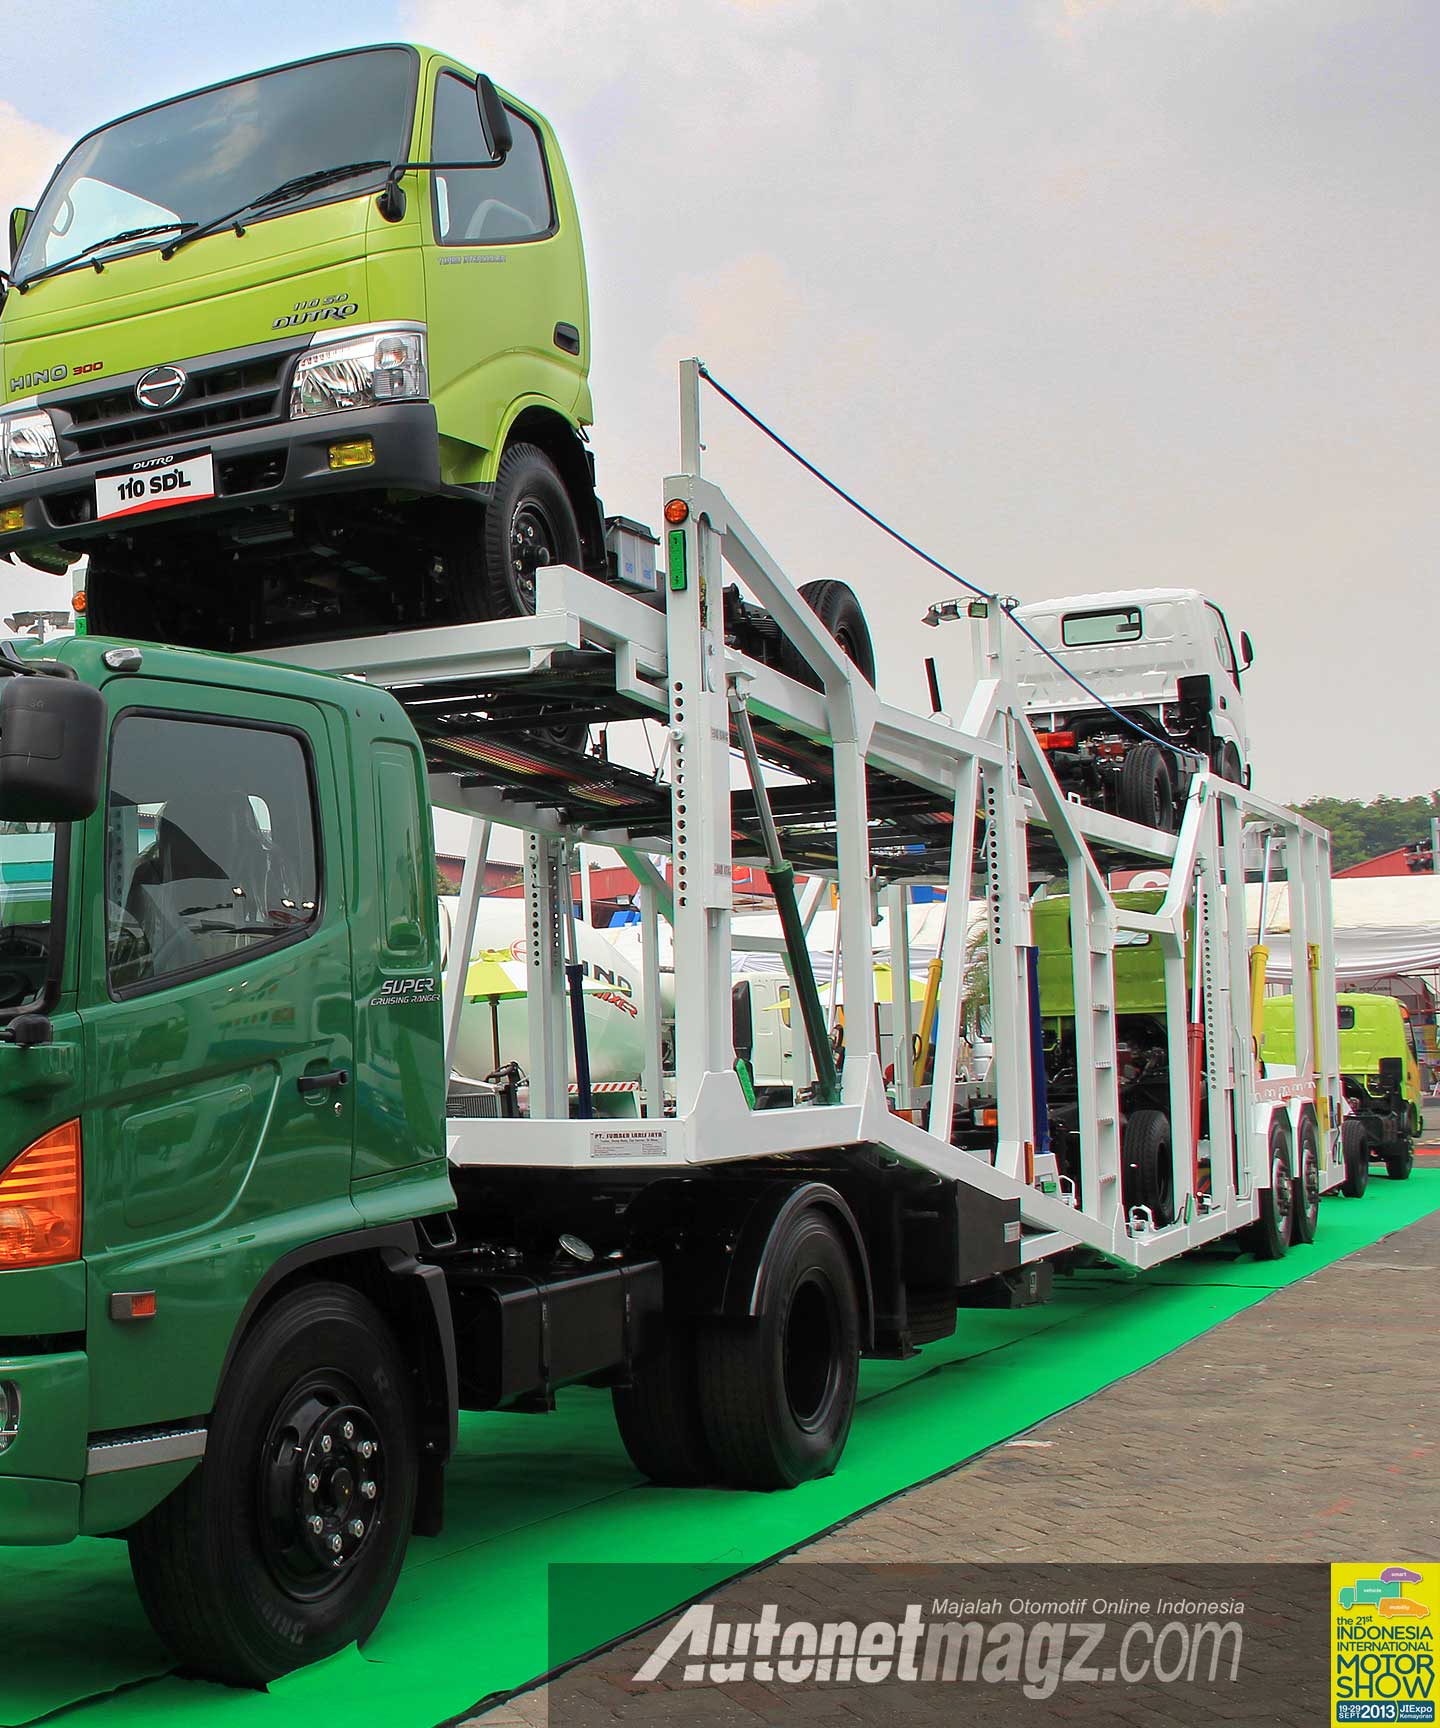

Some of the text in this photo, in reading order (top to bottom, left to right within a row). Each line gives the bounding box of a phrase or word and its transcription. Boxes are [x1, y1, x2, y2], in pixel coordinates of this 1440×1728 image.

[294, 298, 321, 311] 110
[272, 303, 358, 330] DUTRO
[10, 361, 104, 392] HINO 300
[132, 455, 174, 470] DUTRO
[117, 470, 192, 500] 110 SDL
[380, 977, 435, 995] SUPER
[564, 957, 633, 998] INO
[370, 993, 441, 1006] CRUISING RANGER
